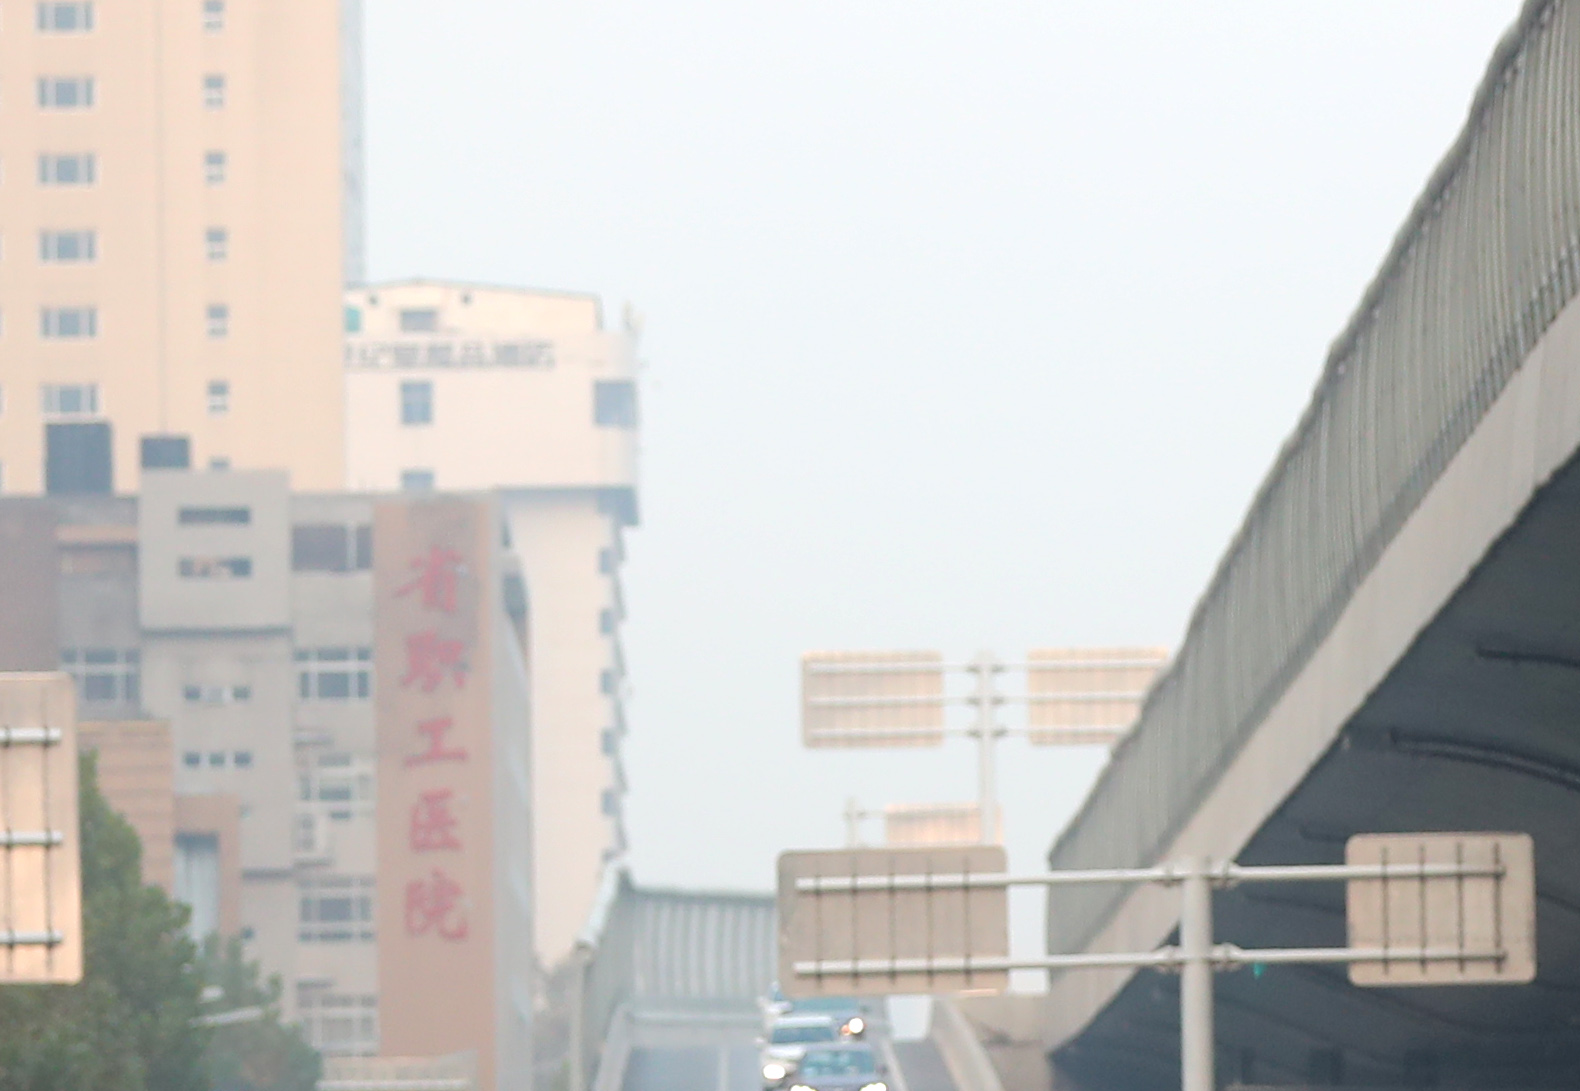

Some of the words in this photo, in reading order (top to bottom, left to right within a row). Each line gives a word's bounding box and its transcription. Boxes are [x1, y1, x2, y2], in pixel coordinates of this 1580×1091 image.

[396, 546, 469, 942] 省职工医院
